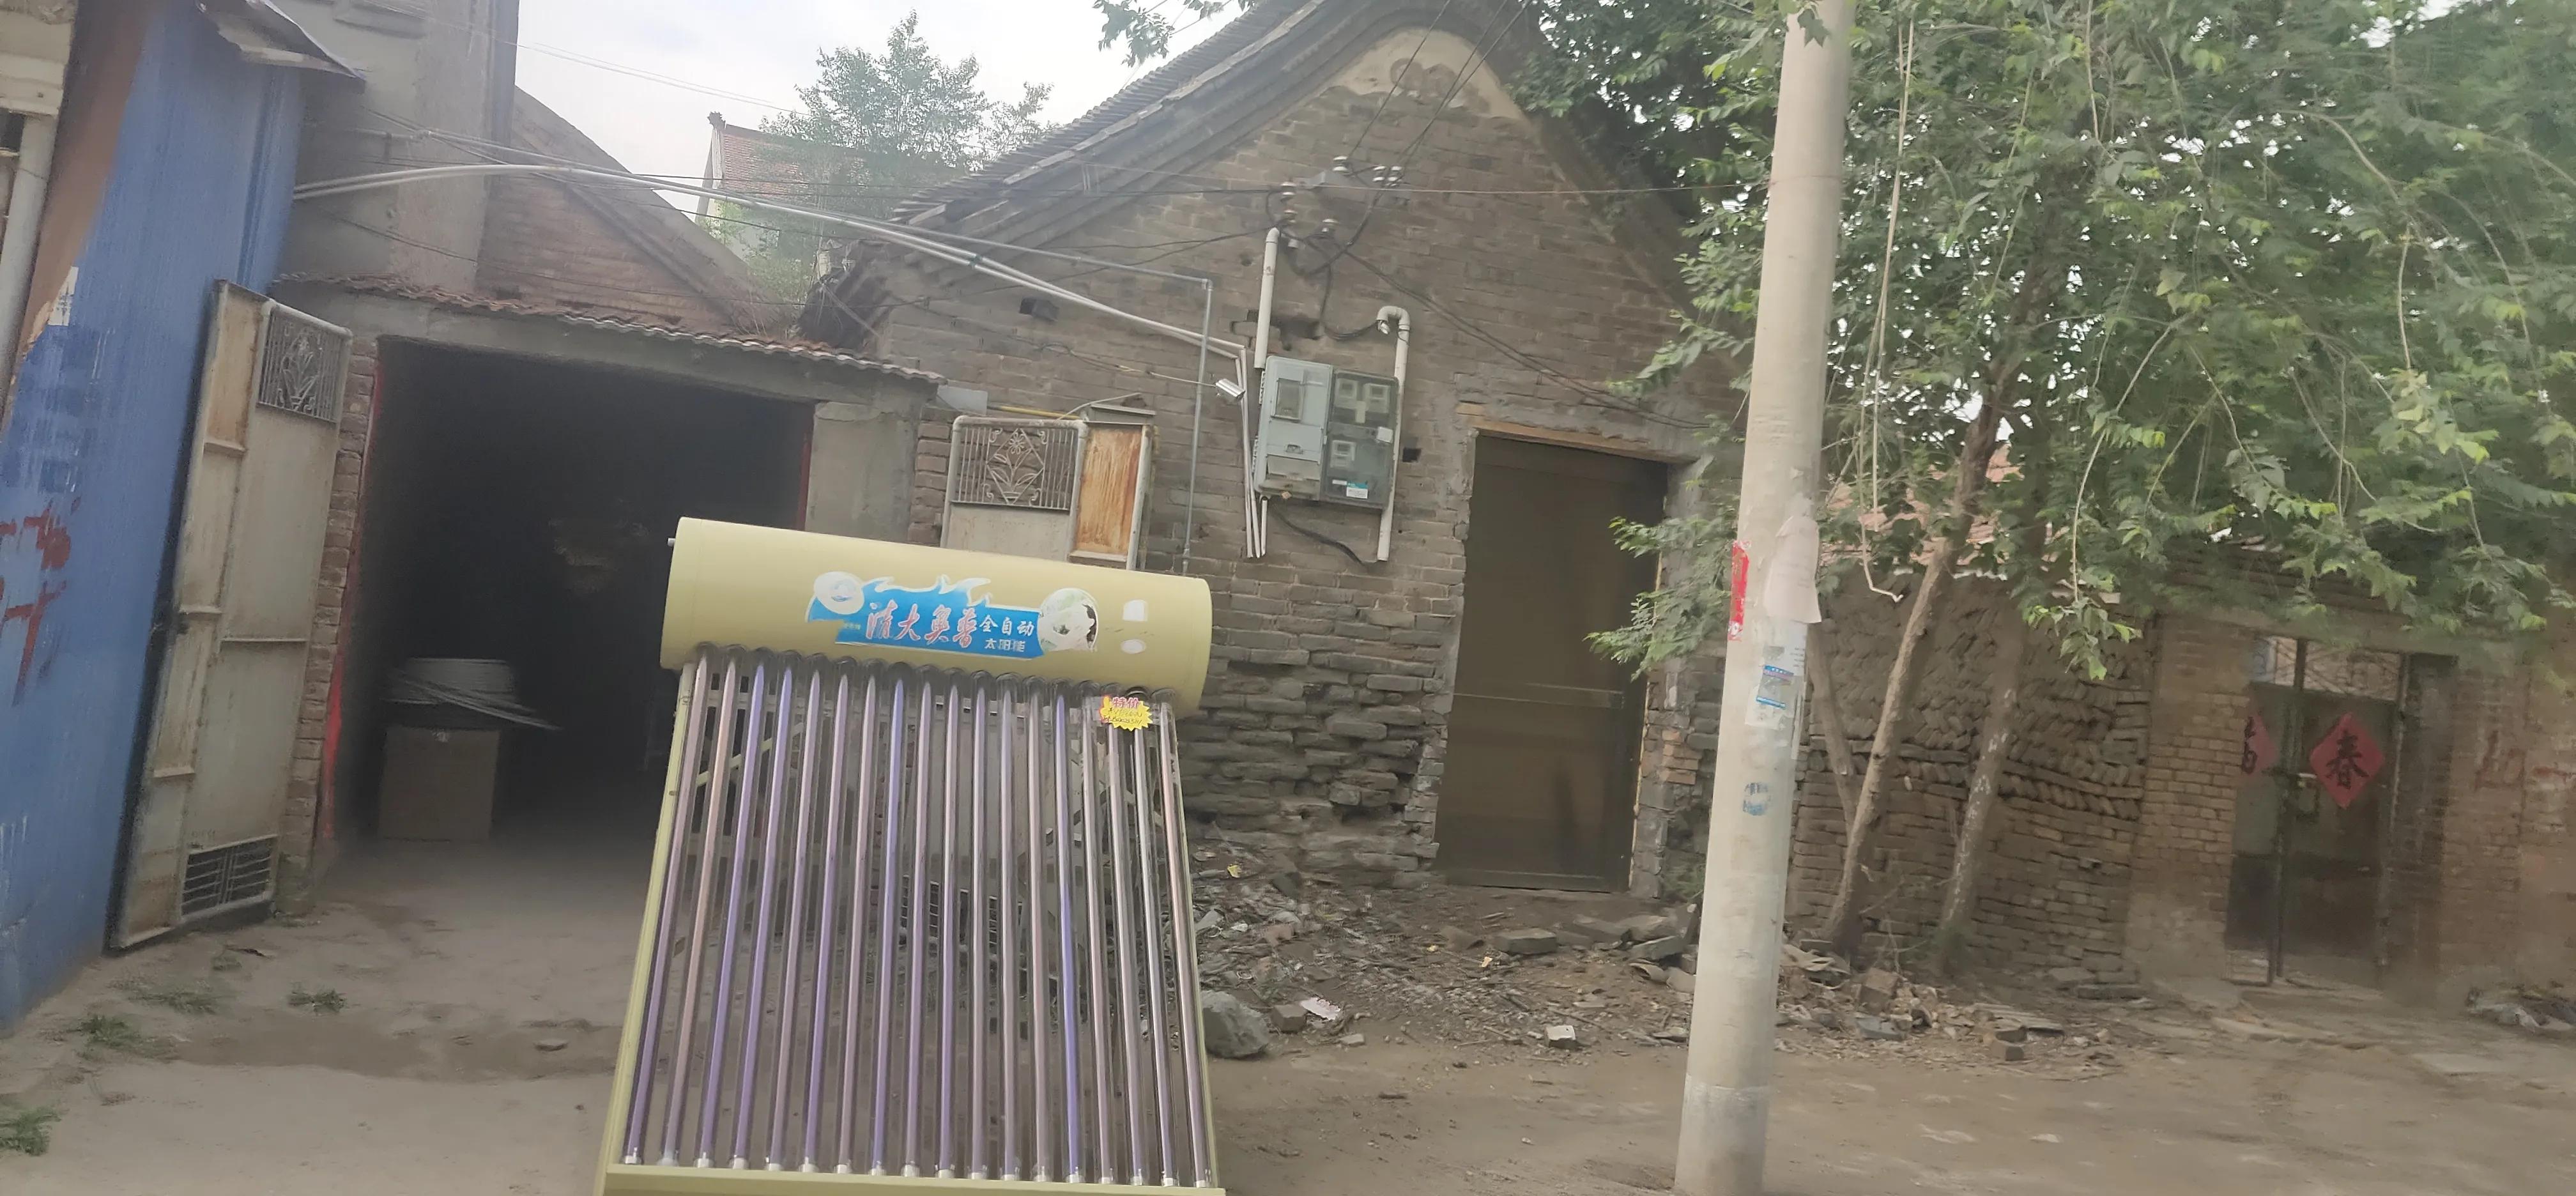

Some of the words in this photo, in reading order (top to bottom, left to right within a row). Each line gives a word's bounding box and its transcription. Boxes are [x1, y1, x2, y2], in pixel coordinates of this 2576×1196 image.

[979, 614, 1034, 636] 全自动
[2326, 729, 2370, 790] 春
